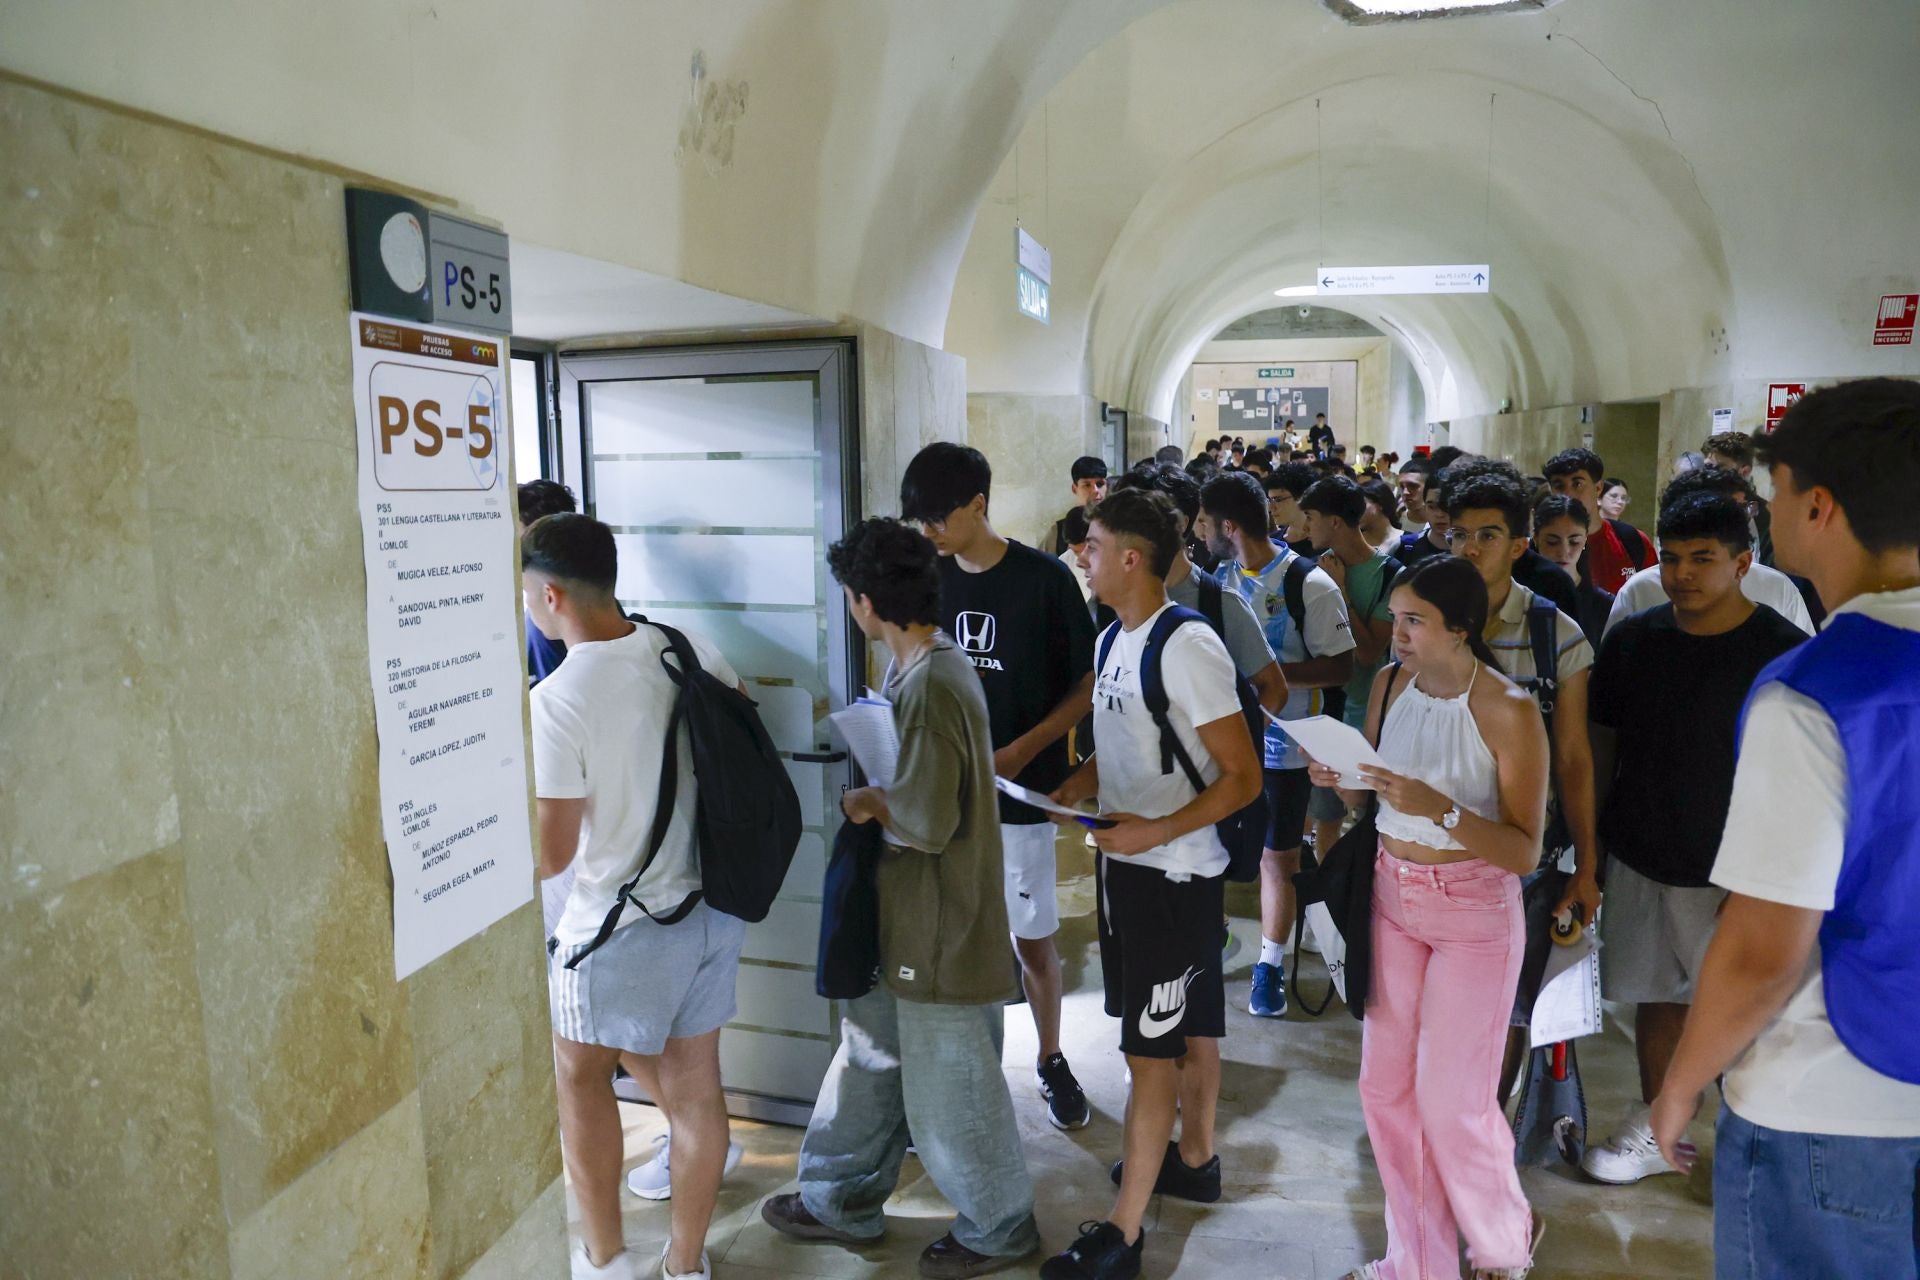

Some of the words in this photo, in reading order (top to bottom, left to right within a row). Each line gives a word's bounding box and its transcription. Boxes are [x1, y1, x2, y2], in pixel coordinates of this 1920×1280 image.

[444, 260, 501, 314] PS-5
[422, 335, 450, 347] PRUEBAS
[420, 345, 429, 353] DE
[430, 347, 453, 357] ACCESO
[1270, 369, 1292, 377] SALIDA
[378, 395, 493, 459] PS-5
[376, 503, 392, 513] PS5
[378, 517, 390, 526] 301
[391, 515, 419, 526] LENGUA
[420, 513, 460, 523] CASTELLANA
[461, 513, 466, 521] Y
[467, 511, 502, 521] LITERATURA
[379, 540, 409, 551] LOMLOE
[387, 560, 397, 569] DE
[397, 568, 426, 581] MUGICA
[452, 562, 483, 574] ALFONSO
[398, 600, 437, 615] SANDOVAL
[461, 593, 484, 604] HENRY
[398, 615, 422, 628] DAVID
[386, 658, 402, 670] PS5
[400, 664, 431, 679] HISTORIA
[432, 661, 441, 671] DE
[442, 659, 451, 669] LA
[967, 655, 1004, 670] NDA
[388, 679, 417, 695] LOMLOE
[408, 703, 439, 720] AGUILAR
[482, 688, 493, 699] EDI
[408, 717, 436, 733] YEREMI
[463, 732, 486, 748] JUDITH
[398, 800, 414, 813] PS5
[401, 813, 413, 826] 303
[402, 818, 431, 837] LOMLOE
[476, 814, 498, 832] PEDRO
[421, 849, 451, 873] ANTONIO
[423, 882, 452, 904] SEGURA
[472, 858, 496, 877] MARTA
